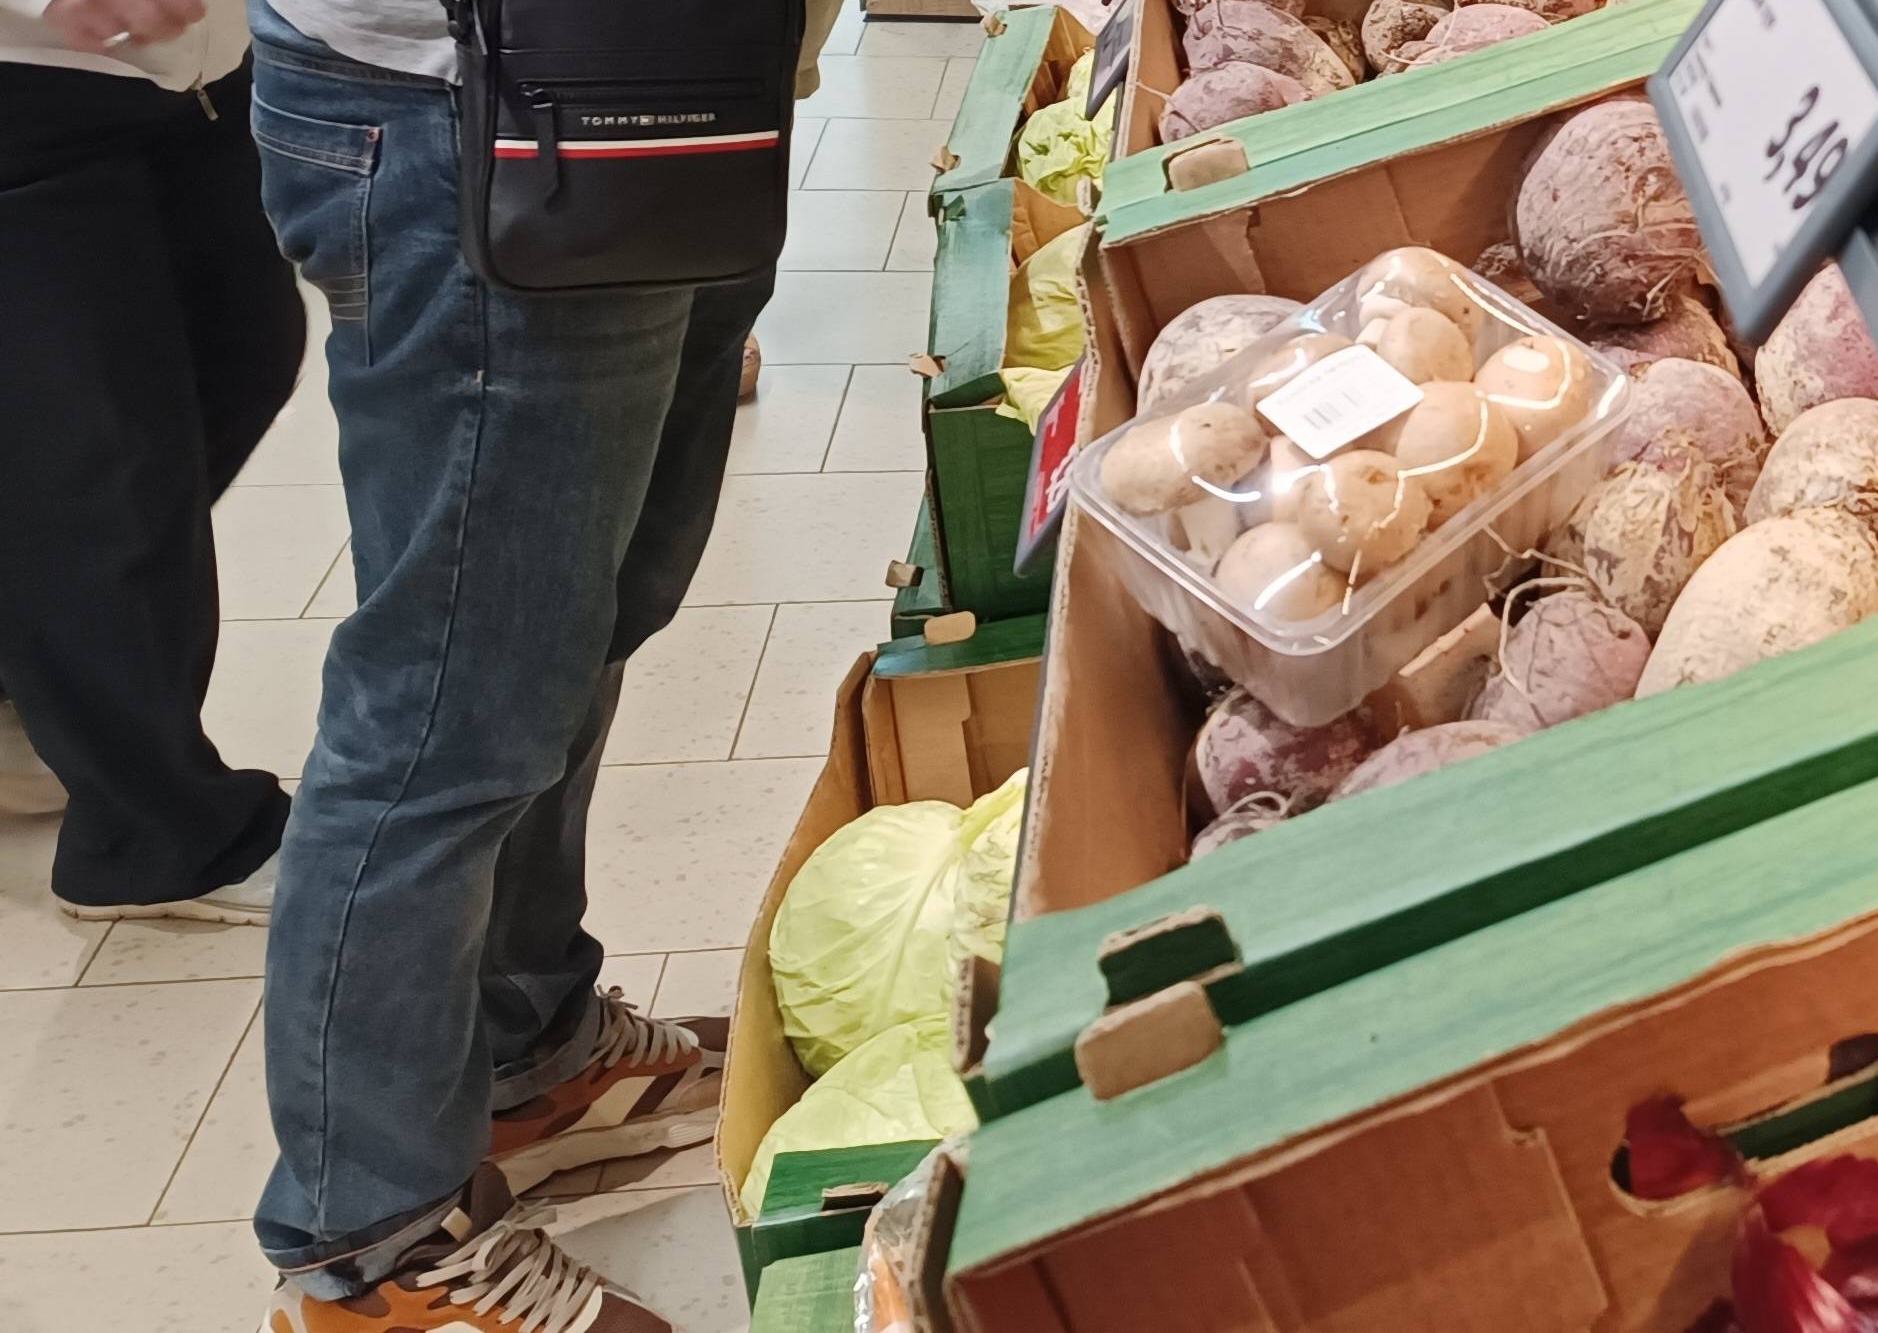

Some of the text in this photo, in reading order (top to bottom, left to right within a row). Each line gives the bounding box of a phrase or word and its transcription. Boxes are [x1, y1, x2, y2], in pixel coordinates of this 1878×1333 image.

[581, 113, 716, 126] TOMMY HILFIGER
[1762, 86, 1848, 211] 3,49
